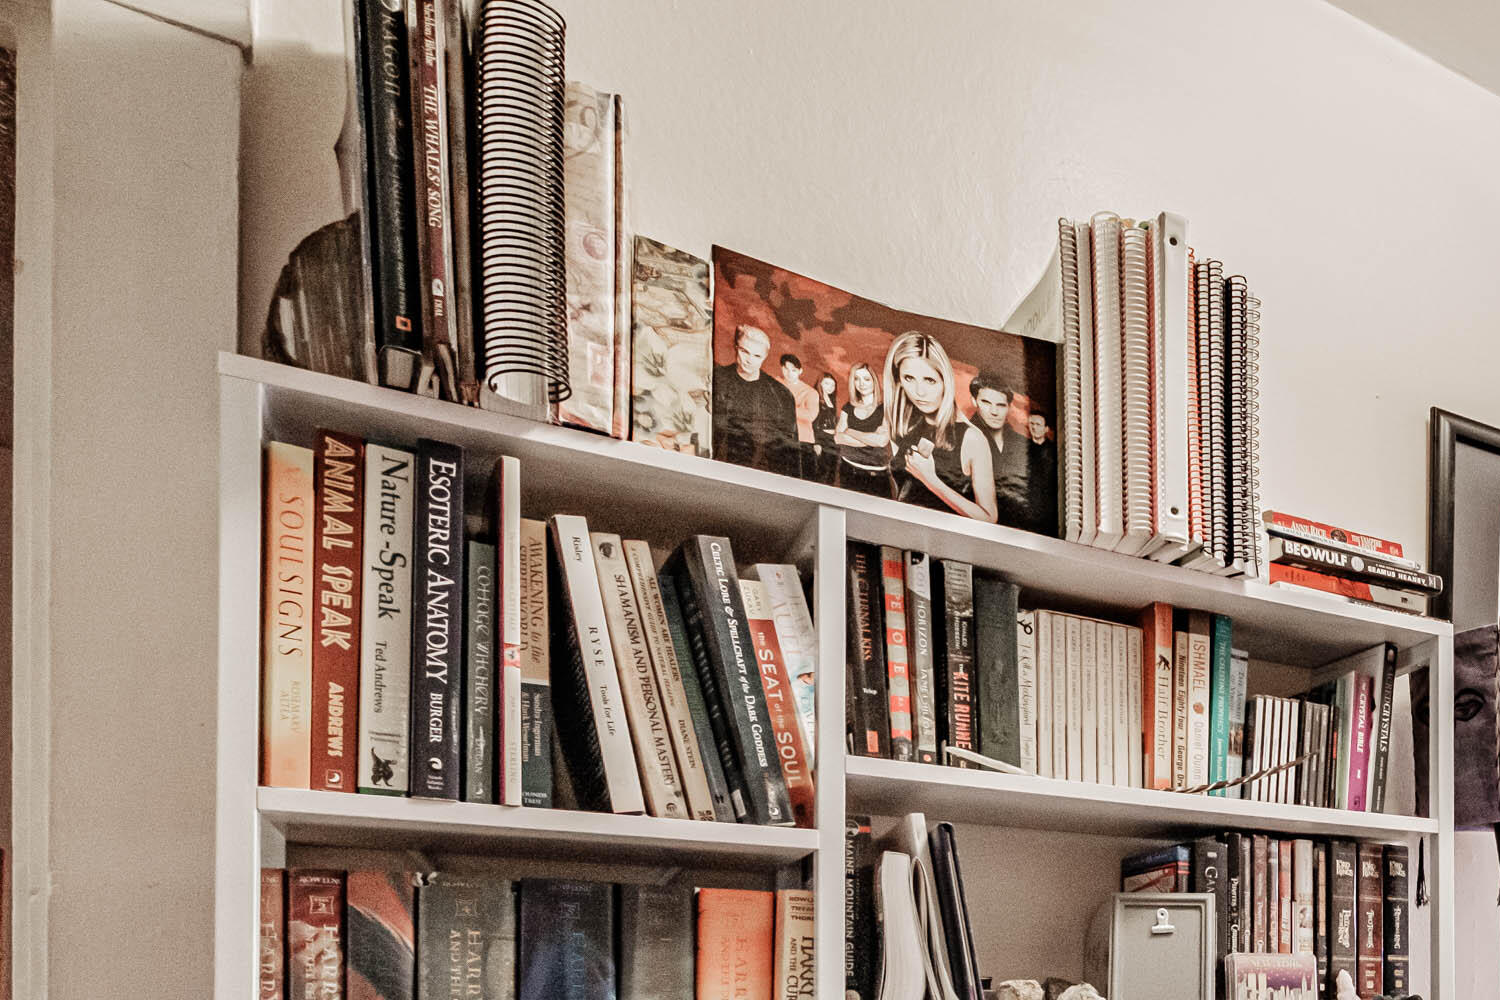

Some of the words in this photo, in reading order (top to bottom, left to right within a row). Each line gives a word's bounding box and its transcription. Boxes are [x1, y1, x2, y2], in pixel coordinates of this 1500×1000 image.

[422, 84, 437, 117] THE
[428, 188, 443, 229] SONG
[433, 299, 444, 317] DIAL
[322, 436, 356, 550] ANIMAL
[427, 457, 457, 566] ESOTERIC
[571, 535, 585, 562] Risley
[1285, 540, 1348, 567] BEOWULF
[278, 495, 305, 657] SOULSIGNS
[528, 536, 545, 628] AWAKENING
[718, 577, 731, 605] LORE
[1367, 565, 1396, 578] SEAMUS
[1398, 572, 1426, 586] HEANEY
[320, 562, 354, 651] SPEAK
[614, 573, 640, 645] SHAMANISM
[652, 592, 665, 623] WOMEN
[661, 624, 671, 643] ARE
[425, 568, 455, 684] ANATOMY
[531, 630, 543, 643] to
[757, 631, 766, 646] the
[916, 599, 928, 656] HORIZON
[961, 620, 969, 648] KHALED
[375, 640, 388, 664] Ted
[531, 645, 544, 665] the
[632, 646, 648, 675] AND
[726, 618, 748, 677] SPELLCRAFT
[863, 637, 872, 661] KISS
[1219, 641, 1227, 656] THE
[759, 649, 783, 706] SEAT
[1178, 654, 1186, 687] Nineteen
[1192, 639, 1207, 693] ISHMAEL
[373, 665, 388, 714] Andrews
[599, 684, 608, 706] Tools
[638, 675, 661, 733] PERSONAL
[953, 671, 970, 704] KITE
[1158, 675, 1170, 706] Half
[327, 681, 345, 758] ANDREWS
[429, 692, 444, 743] BURGER
[603, 707, 612, 718] for
[744, 695, 759, 722] DARK
[773, 703, 781, 712] of
[1358, 693, 1367, 729] CRYSTAL
[605, 719, 616, 736] Life
[678, 719, 689, 743] DIANE
[685, 743, 697, 769] STEIN
[751, 723, 768, 768] GODDESS
[1157, 708, 1170, 760] Brother
[1379, 702, 1392, 753] CRYSTALS
[654, 735, 676, 787] MASTERY
[778, 731, 801, 788] SOUL
[1176, 744, 1184, 771] George
[846, 839, 855, 875] MAINE
[846, 878, 855, 941] MOUNTAIN
[450, 929, 461, 962] AND
[845, 941, 855, 978] GUIDE
[450, 965, 461, 994] THE
